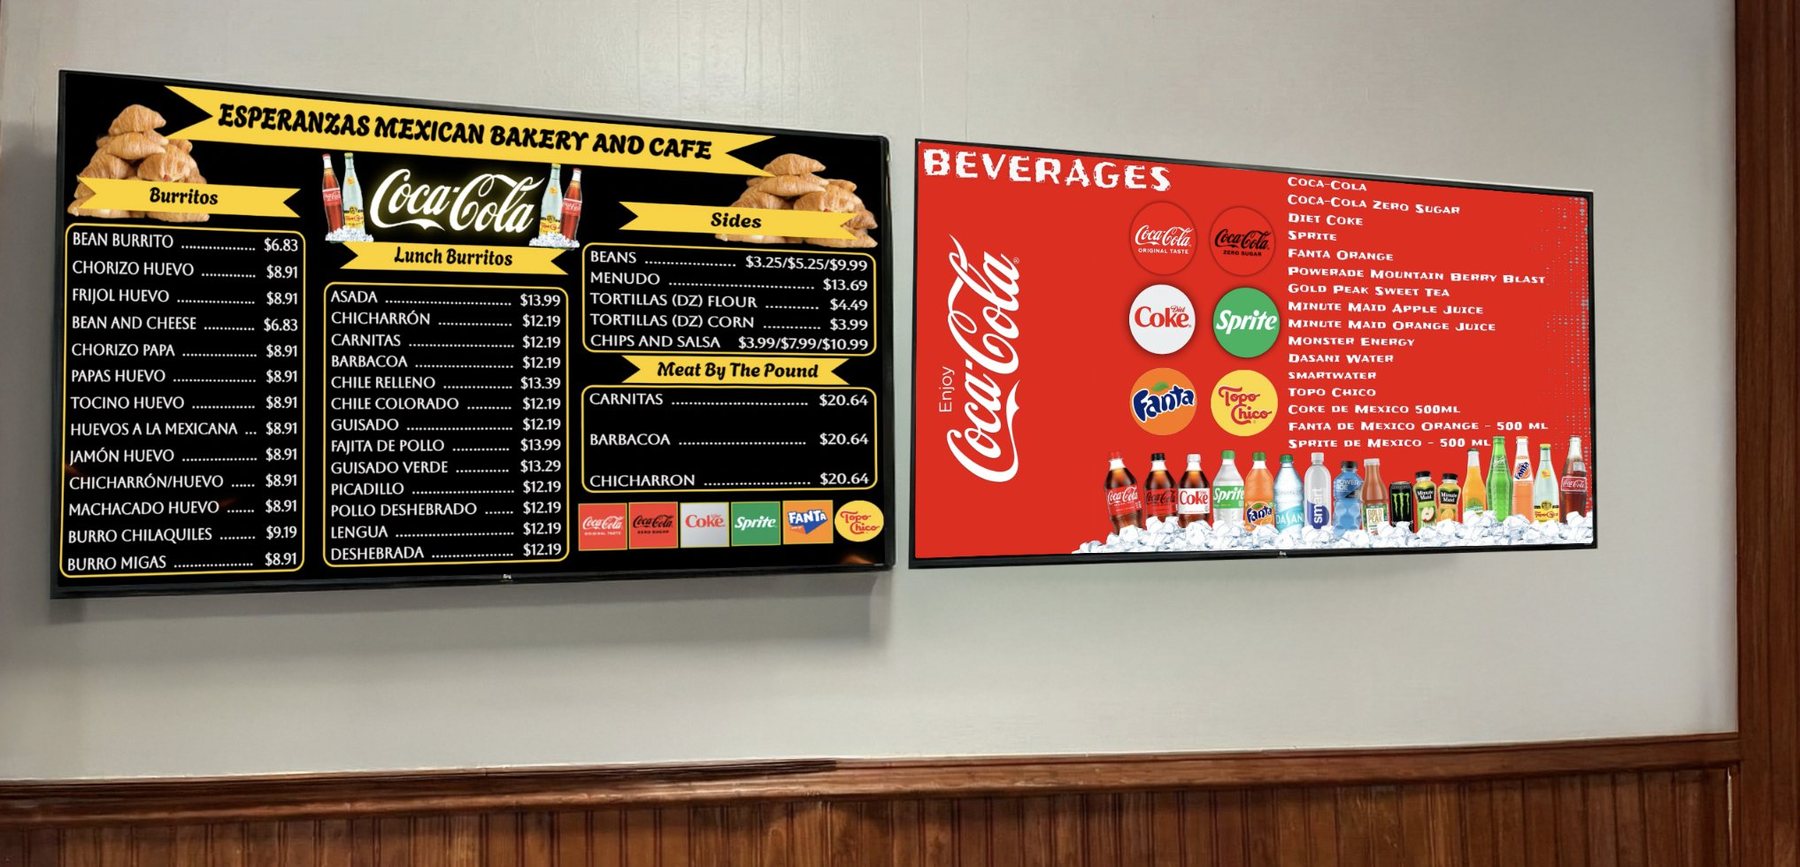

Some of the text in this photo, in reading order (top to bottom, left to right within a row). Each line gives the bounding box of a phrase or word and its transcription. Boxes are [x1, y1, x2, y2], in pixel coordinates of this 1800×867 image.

[218, 104, 711, 159] ESPERANZAS MEXICAN BAKERY AND CAFE
[924, 149, 1171, 191] BEVERAGES
[150, 187, 217, 204] Burritos
[370, 169, 545, 233] Coca-Cola
[711, 213, 761, 228] Sides
[73, 232, 298, 252] BEAN BURRITO $6.83
[1135, 225, 1193, 246] Coca-Cola
[1215, 229, 1271, 249] Coca-Cola
[395, 247, 512, 265] Lunch Burritos
[591, 251, 867, 271] BEANS $3.25/$5.25/$9.99
[73, 260, 297, 279] CHORIZO HUEVO $8.91
[591, 272, 867, 291] MENUDO $13.69
[73, 288, 297, 305] FRIJOL HUEVO $8.91
[331, 290, 560, 307] ASADA $13.99
[590, 293, 868, 311] TORTILLAS (DZ) FLOUR $4.49
[73, 316, 298, 332] BEAN AND CHEESE $6.83
[331, 310, 560, 327] CHICHARRÓN $12.19
[590, 314, 868, 331] TORTILLAS (DZ) CORN $3.99
[1134, 306, 1189, 328] Coke
[1216, 310, 1277, 334] Sprite
[331, 334, 560, 349] CARNITAS $12.19
[591, 334, 868, 350] CHIPS AND SALSA $3.99/$7.99/$10.99
[72, 343, 297, 358] CHORIZO PAPA $8.91
[947, 234, 1020, 483] Coca-Cola
[332, 355, 560, 369] BARBACOA $12.19
[72, 369, 297, 383] PAPAS HUEVO $8.91
[658, 362, 818, 380] Meat By The Pound
[331, 376, 560, 390] CHILE RELLENO $13.39
[939, 367, 955, 413] Enjoy
[70, 395, 297, 409] TOCINO HUEVO $8.91
[331, 397, 561, 410] CHILE COLORADO $12.19
[590, 393, 868, 407] CARNITAS $20.64
[1133, 386, 1194, 422] Fanta
[1218, 386, 1260, 406] Topo
[1231, 403, 1272, 425] Chico
[71, 421, 297, 436] HUEVOS A LA MEXICANA $8.91
[331, 418, 561, 431] GUISADO $12.19
[332, 438, 561, 455] FAJITA DE POLLO $13.99
[590, 433, 868, 445] BARBACOA $20.64
[70, 447, 297, 466] JAMÓN HUEVO $8.91
[331, 459, 561, 474] GUISADO VERDE $13.29
[70, 473, 296, 489] CHICHARRÓN/HUEVO $8.91
[332, 480, 561, 495] PICADILLO $12.19
[590, 472, 869, 487] CHICHARRON $20.64
[1180, 491, 1208, 504] Coke
[69, 499, 296, 516] MACHACADO HUEVO $8.91
[331, 501, 561, 517] POLLO DESHEBRADO $12.19
[685, 514, 724, 528] Coke
[735, 516, 776, 531] Sprite
[788, 510, 827, 524] FANTA
[840, 511, 871, 523] Topo
[69, 525, 297, 544] BURRO CHILAQUILES $9.19
[331, 522, 561, 538] LENGUA $12.19
[850, 523, 880, 534] Chico
[331, 543, 561, 560] DESHEBRADA $12.19
[68, 552, 296, 571] BURRO MIGAS $8.91
